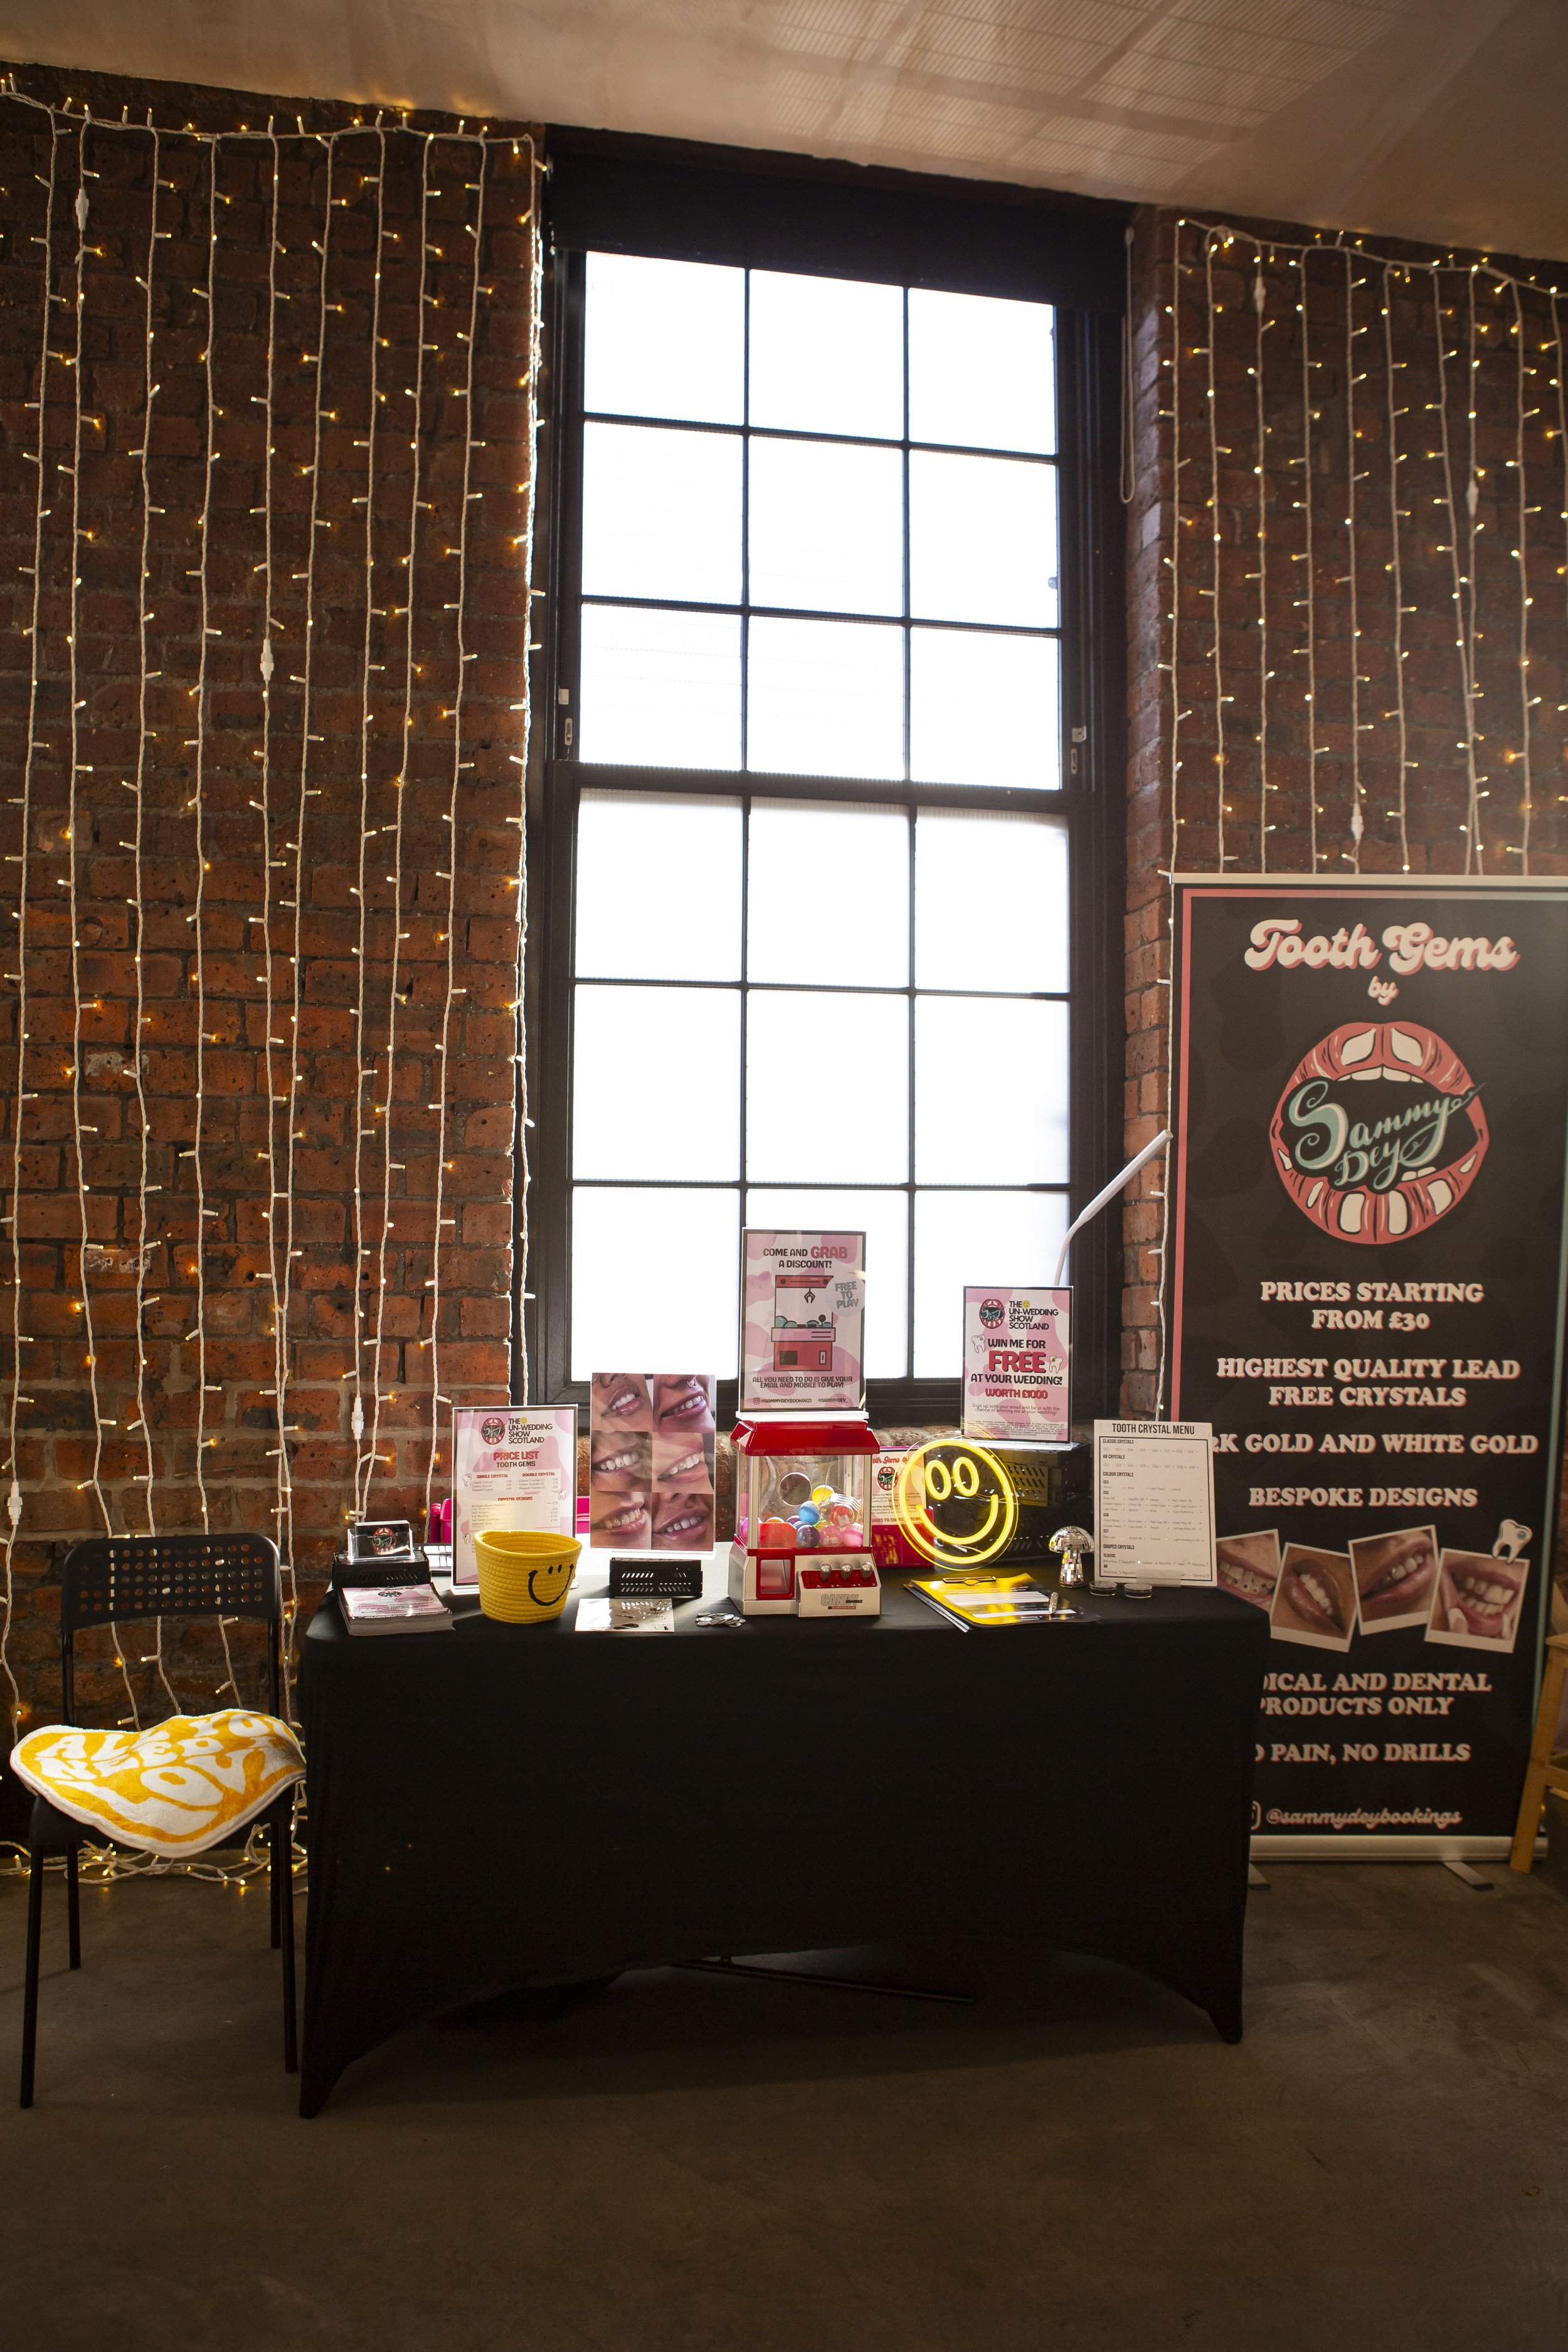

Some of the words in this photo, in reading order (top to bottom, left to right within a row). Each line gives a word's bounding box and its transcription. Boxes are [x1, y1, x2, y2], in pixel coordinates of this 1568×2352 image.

[1244, 919, 1382, 971] Tooth
[1382, 922, 1520, 975] Gems
[1368, 975, 1399, 1005] by
[1288, 1080, 1488, 1170] Sammy
[1334, 1138, 1402, 1190] Dey
[763, 1248, 788, 1257] COME
[790, 1249, 808, 1257] AND
[810, 1246, 848, 1259] GRAB
[787, 1260, 832, 1268] DISCOUNT!
[835, 1281, 857, 1292] FREE
[840, 1291, 853, 1300] TO
[1261, 1281, 1352, 1302] PRICES
[1357, 1282, 1485, 1303] STARTING
[836, 1298, 859, 1309] PLAY
[1009, 1308, 1059, 1316] UN-WEDDING
[1311, 1310, 1384, 1330] FROM
[1389, 1312, 1431, 1332] £30
[988, 1338, 1007, 1348] WIN
[1009, 1339, 1024, 1348] ME
[1026, 1340, 1046, 1348] FOR
[988, 1350, 1046, 1374] FREE
[1217, 1358, 1328, 1378] HIGHEST
[1334, 1359, 1448, 1382] QUALITY
[1452, 1360, 1520, 1380] LEAD
[971, 1374, 983, 1382] AT
[985, 1374, 1012, 1383] YOUR
[1014, 1375, 1062, 1385] WEDDING!
[985, 1388, 1020, 1398] WORTH
[1022, 1389, 1048, 1399] £1000
[1269, 1387, 1334, 1406] FREE
[1340, 1387, 1467, 1407] CRYSTALS
[1112, 1423, 1136, 1433] TOOTH
[1138, 1424, 1171, 1434] CRYSTAL
[1173, 1425, 1194, 1434] MENU
[1245, 1434, 1314, 1453] GOLD
[1319, 1434, 1376, 1453] AND
[1382, 1434, 1465, 1453] WHITE
[1470, 1435, 1539, 1454] GOLD
[493, 1451, 520, 1461] PRICE
[521, 1451, 539, 1459] LIST
[1249, 1488, 1364, 1507] BESPOKE
[1369, 1488, 1478, 1507] DESIGNS
[821, 1594, 859, 1606] CANDY
[1263, 1673, 1327, 1692] ICAL
[1332, 1673, 1387, 1692] AND
[1393, 1673, 1492, 1692] DENTAL
[1388, 1697, 1454, 1716] ONLY
[34, 1736, 224, 1781] NEED
[1270, 1744, 1337, 1765] PAIN,
[1342, 1744, 1379, 1762] NO
[1384, 1744, 1470, 1762] DRILLS
